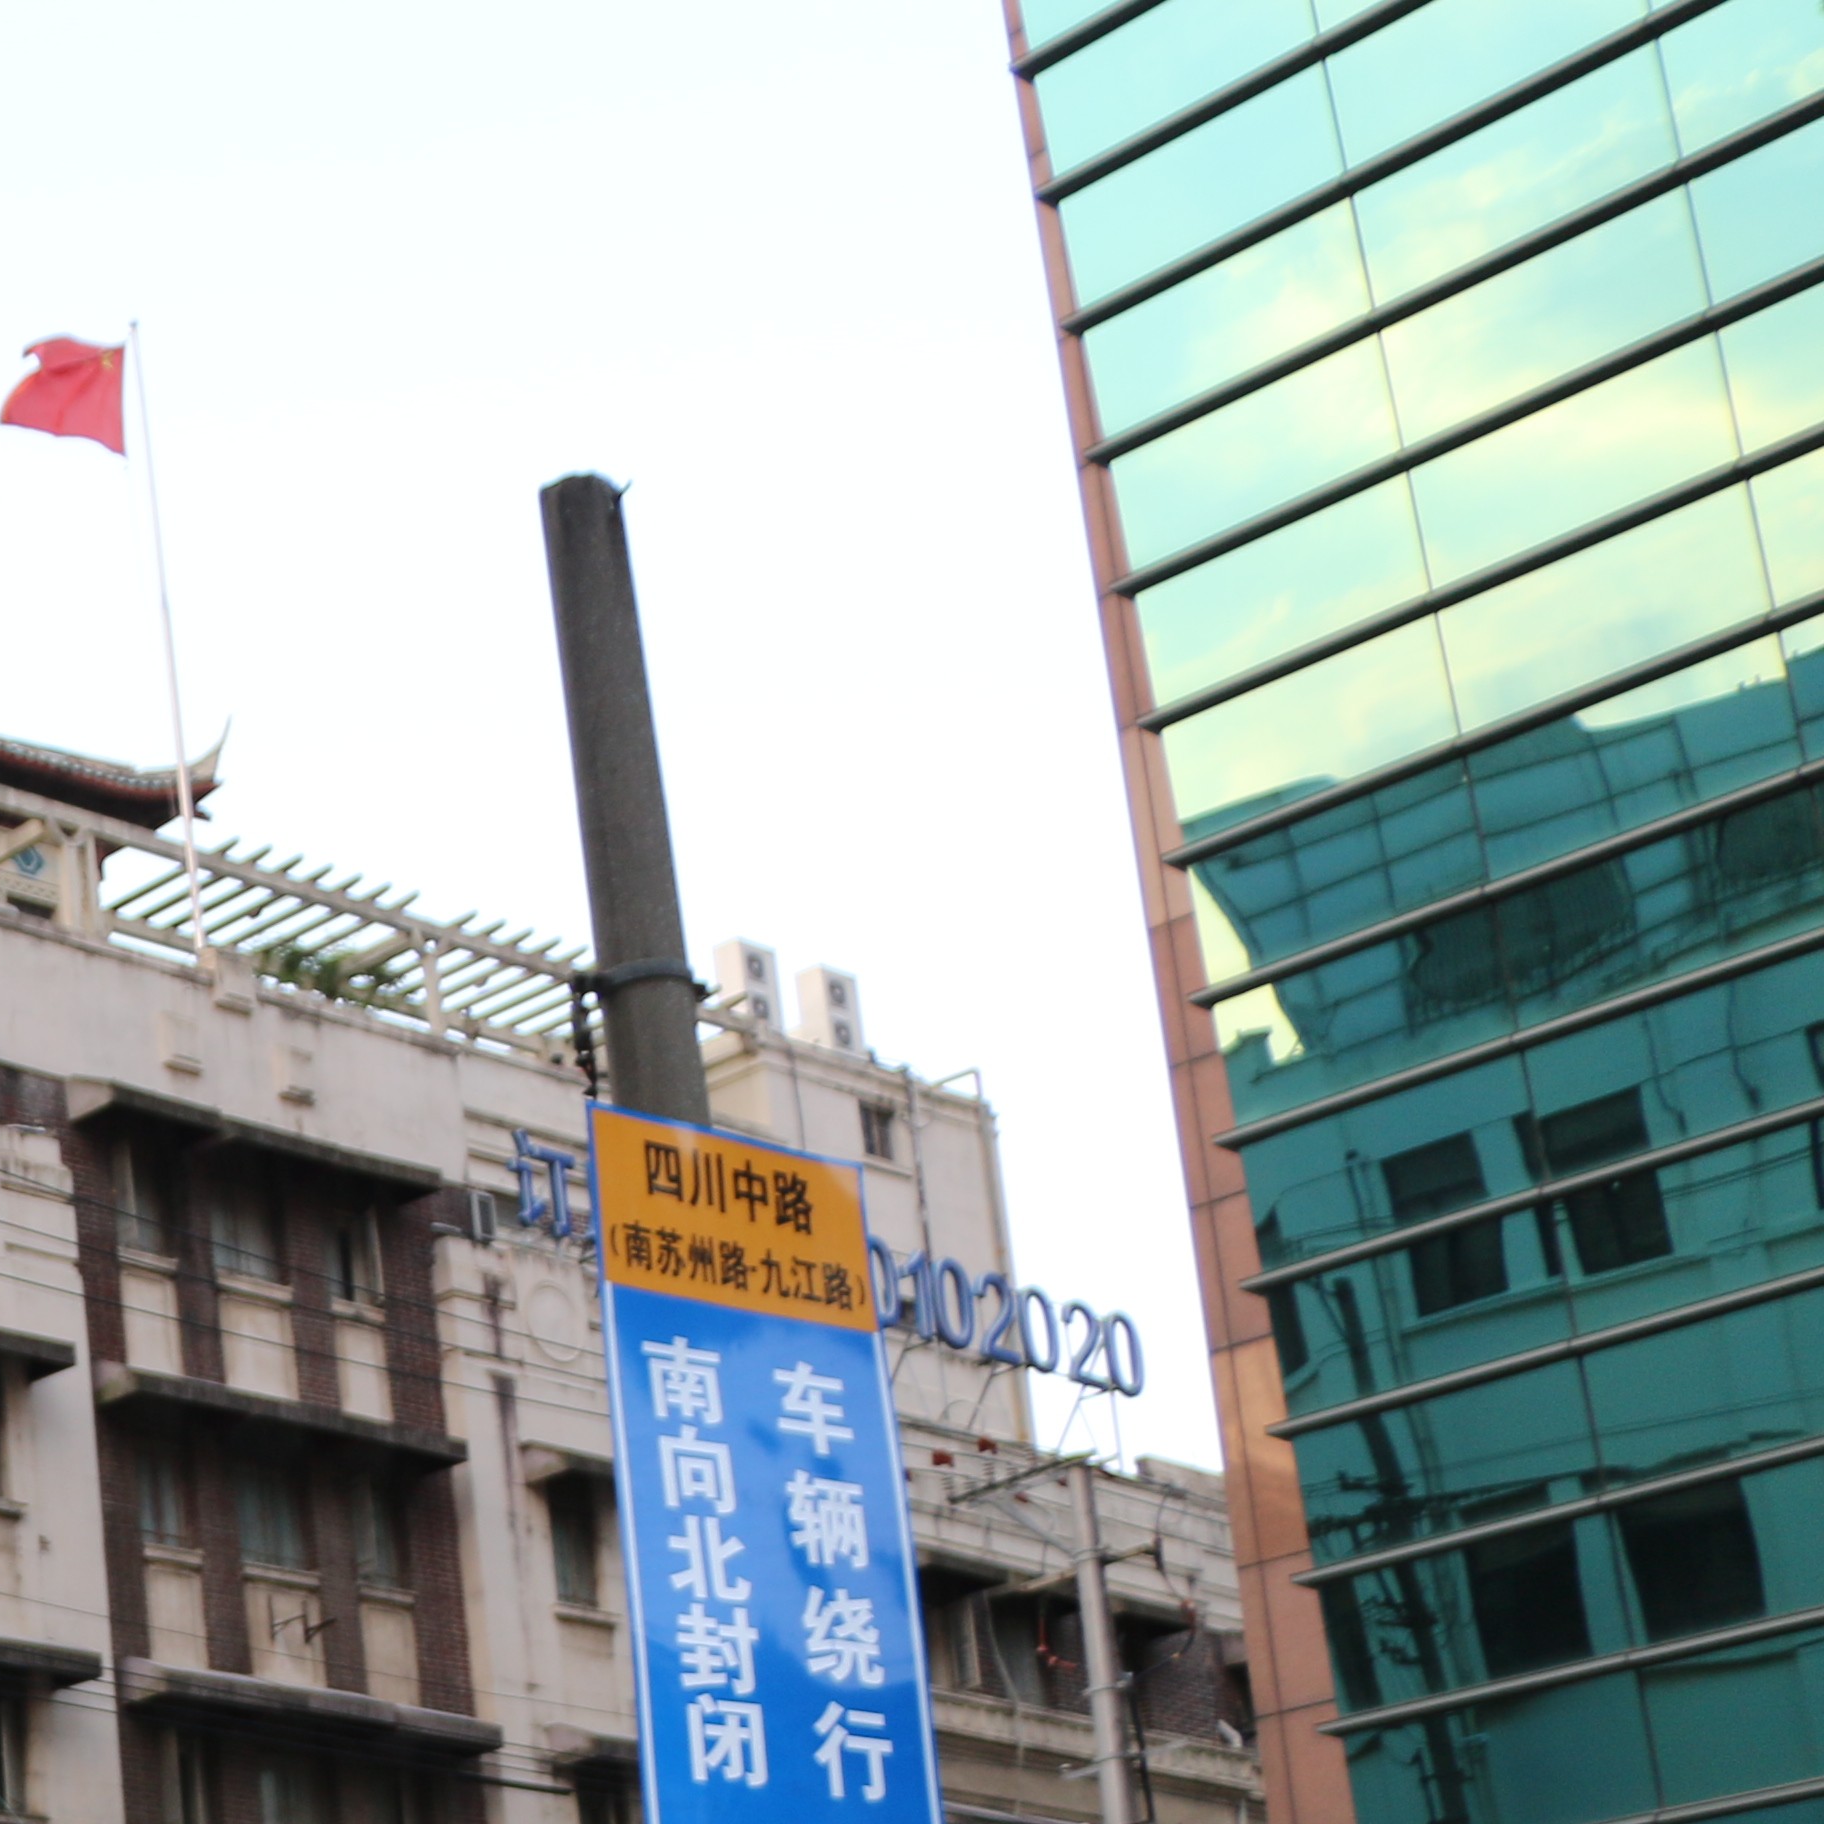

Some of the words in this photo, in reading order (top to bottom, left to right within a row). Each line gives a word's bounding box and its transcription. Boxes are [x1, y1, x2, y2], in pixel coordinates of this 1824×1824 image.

[506, 1128, 596, 1244] 订
[643, 1140, 813, 1236] 四川中路
[640, 1335, 768, 1787] 南向北封闭
[772, 1360, 893, 1802] 车辆绕行
